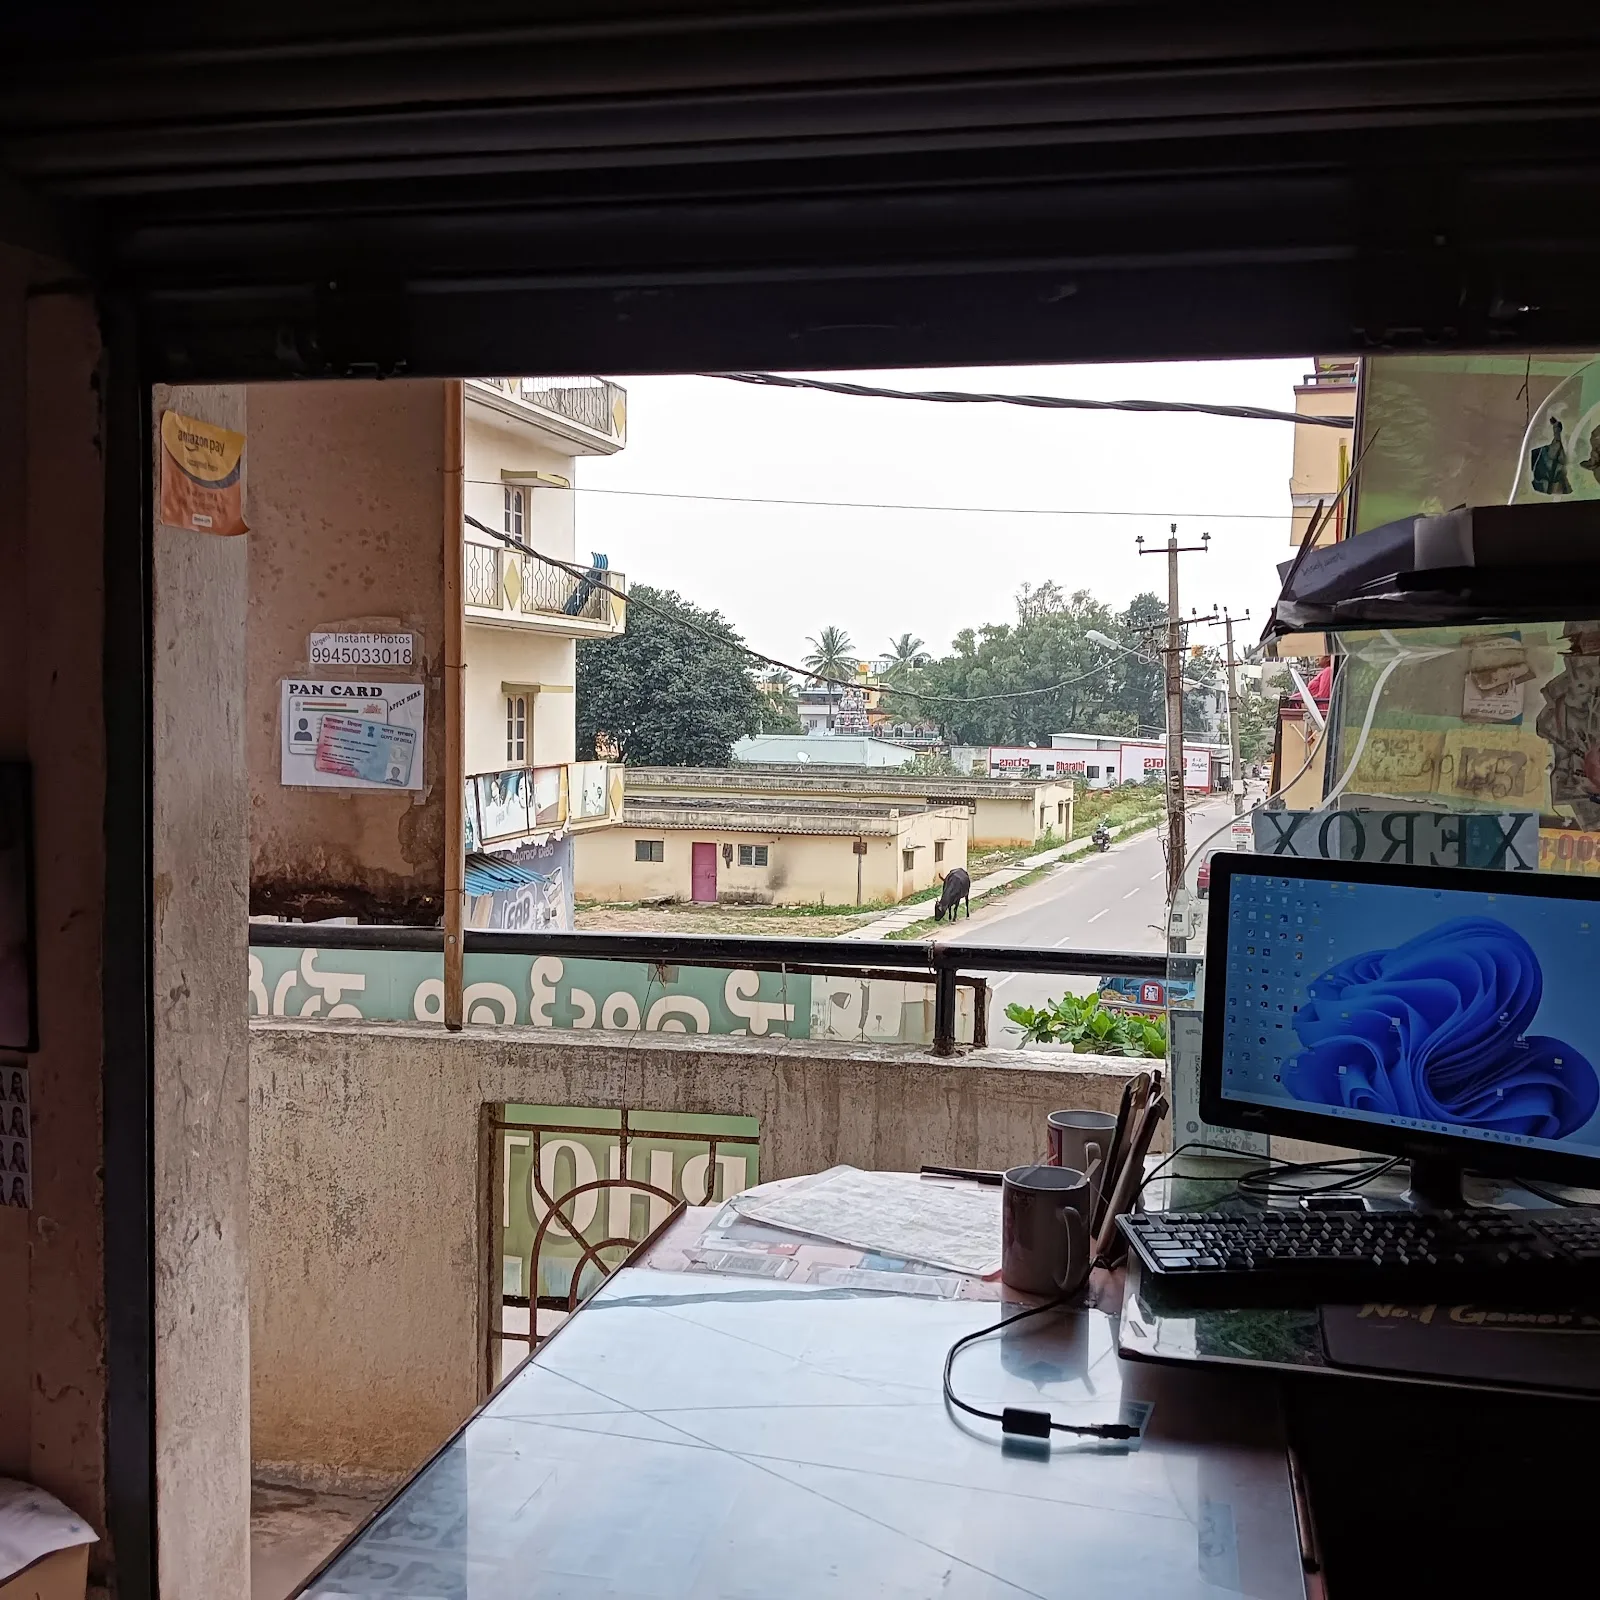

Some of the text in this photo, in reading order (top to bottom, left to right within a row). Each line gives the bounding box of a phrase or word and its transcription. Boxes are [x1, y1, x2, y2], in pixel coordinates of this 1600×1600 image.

[178, 430, 225, 456] amazon pay
[312, 634, 331, 647] Urgent
[334, 634, 410, 644] Instant Photos
[312, 648, 412, 664] 9945033018
[289, 684, 383, 697] PAN CARD
[389, 690, 421, 712] APPLY HERE
[1056, 760, 1085, 771] Bharathi
